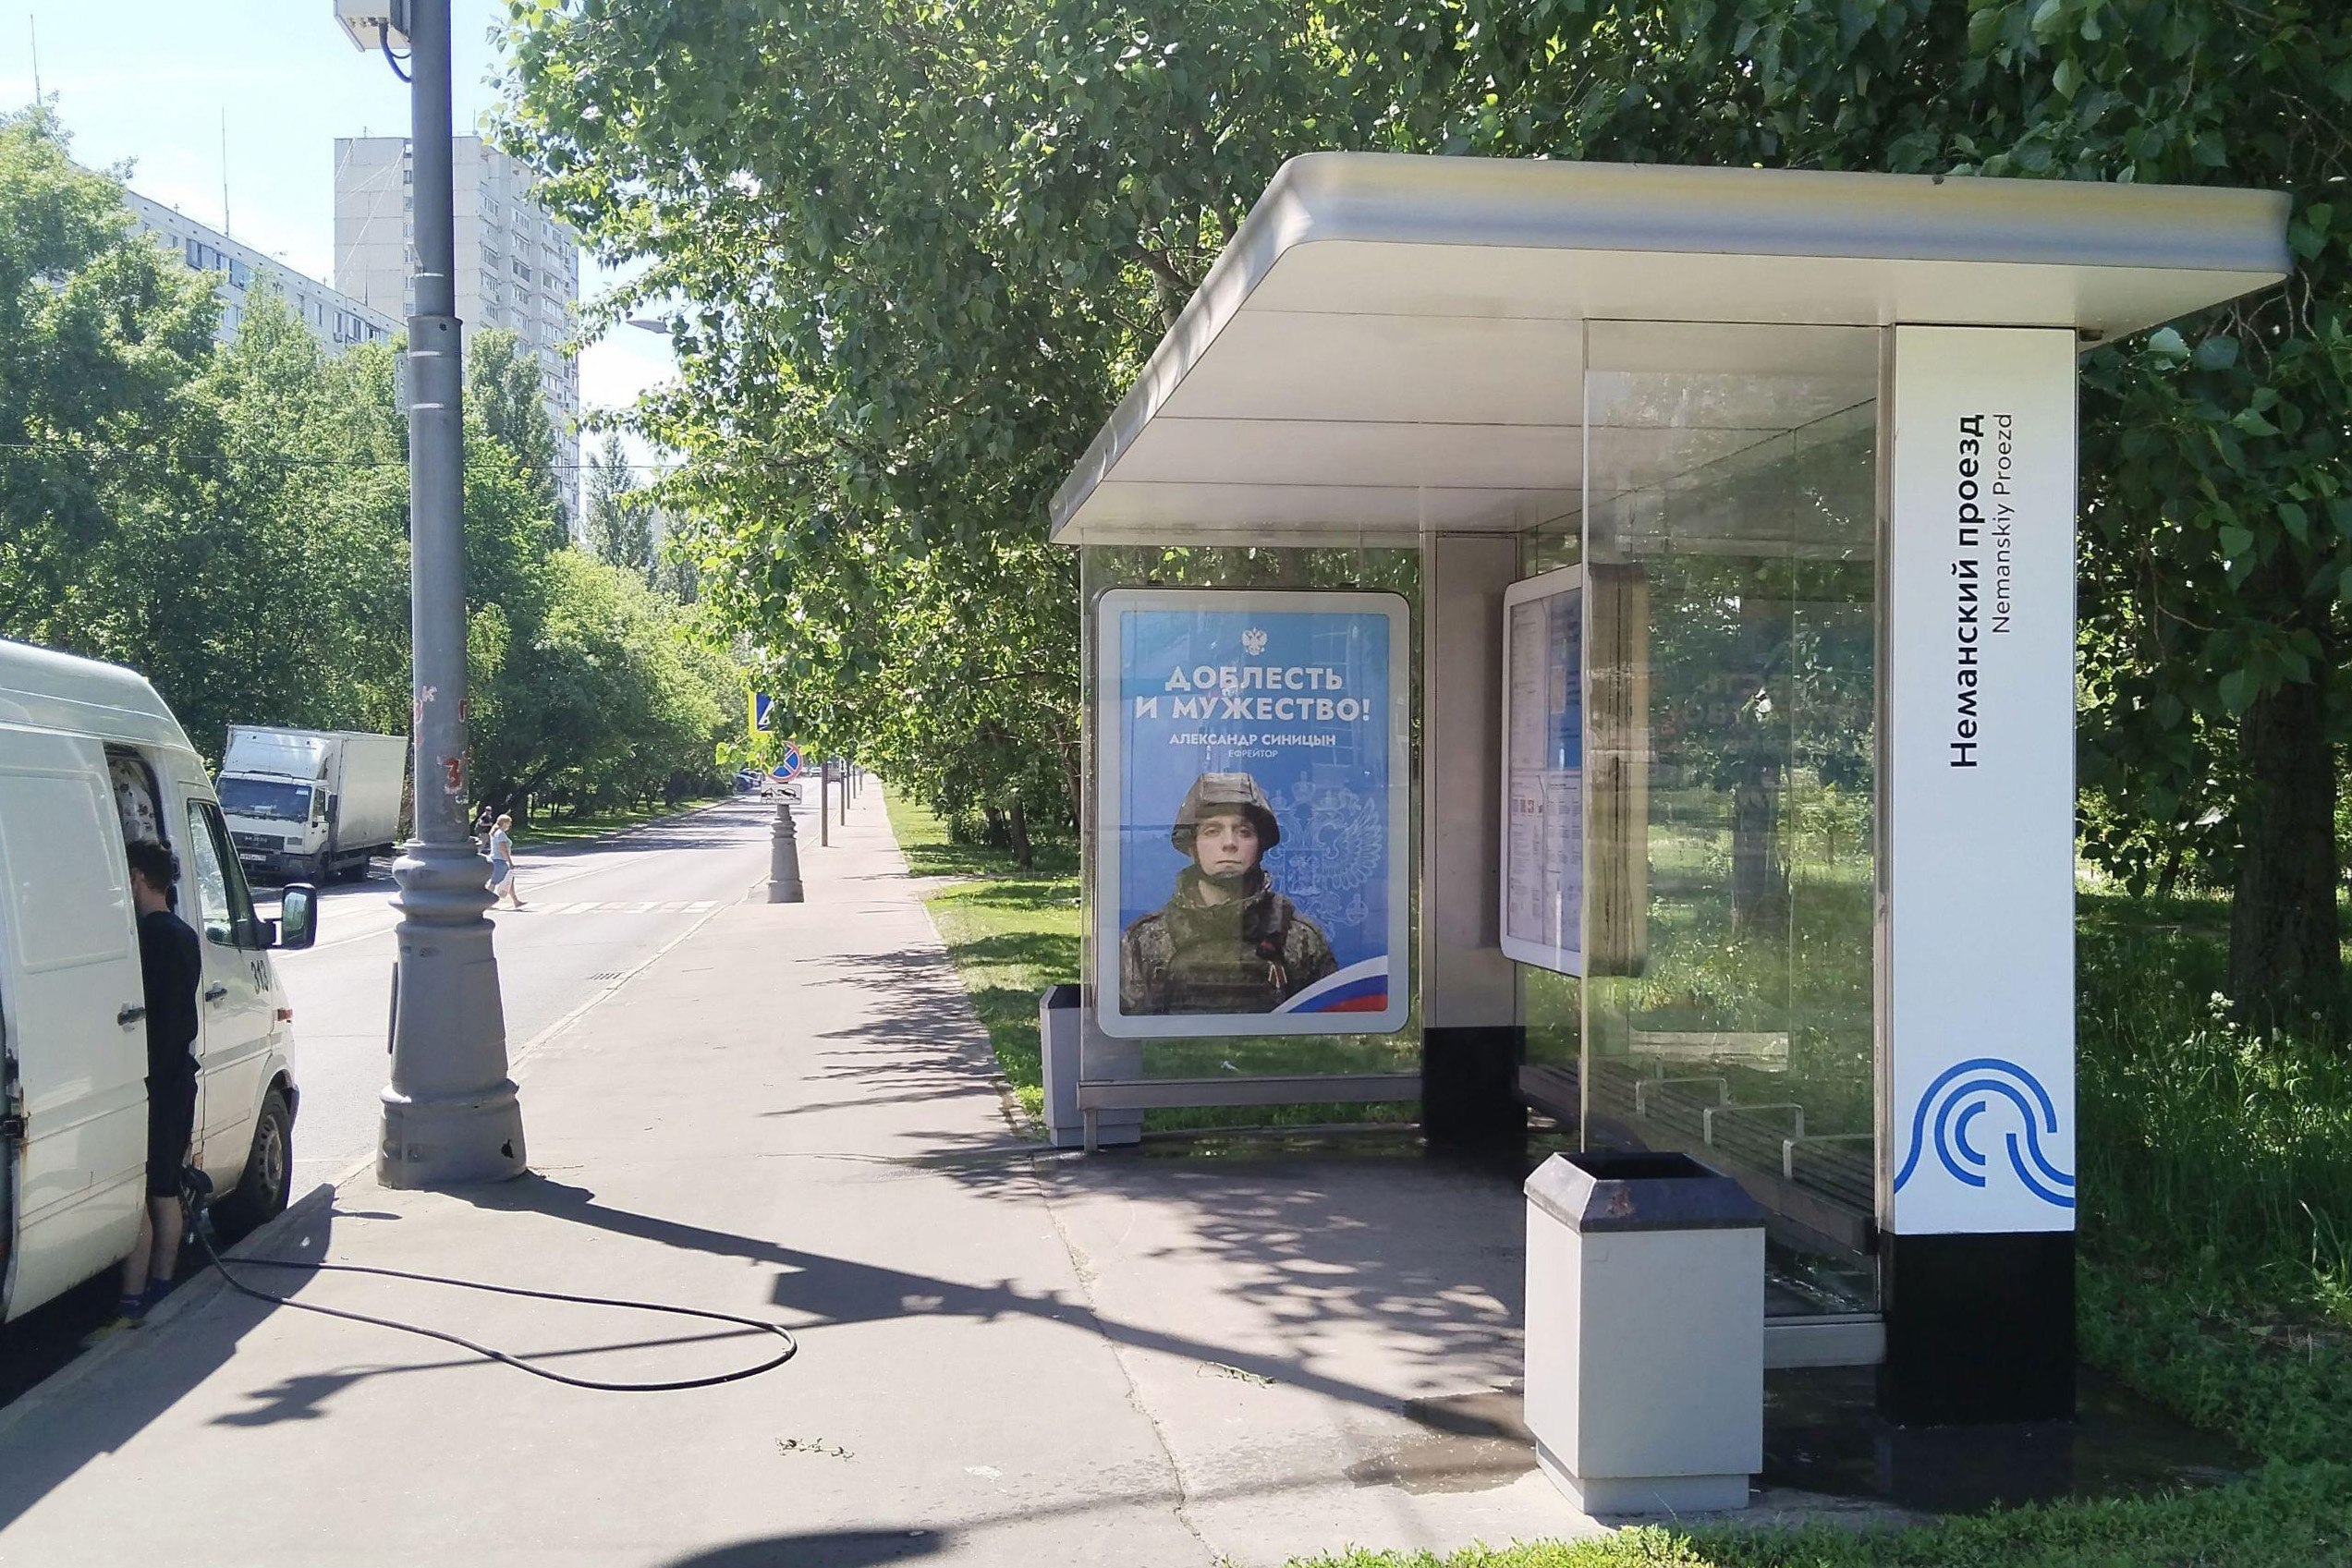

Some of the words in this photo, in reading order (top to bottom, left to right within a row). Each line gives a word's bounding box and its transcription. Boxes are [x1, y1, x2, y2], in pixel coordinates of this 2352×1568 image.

[1992, 414, 2012, 495] Proezd
[1958, 414, 1986, 546] проезд
[1992, 504, 2015, 633] Nemanskiy
[1164, 665, 1343, 692] ДОБЛЕСТЬ
[1950, 559, 1979, 767] Неманский
[1136, 696, 1157, 719] И
[1172, 696, 1371, 721] МУЖЕСТВО!
[1169, 733, 1258, 747] АЛЕКСАНДР
[1261, 734, 1336, 748] СИНИЦЫН
[1228, 748, 1278, 759] ЕФРЕЙТОР
[250, 959, 270, 995] 313
